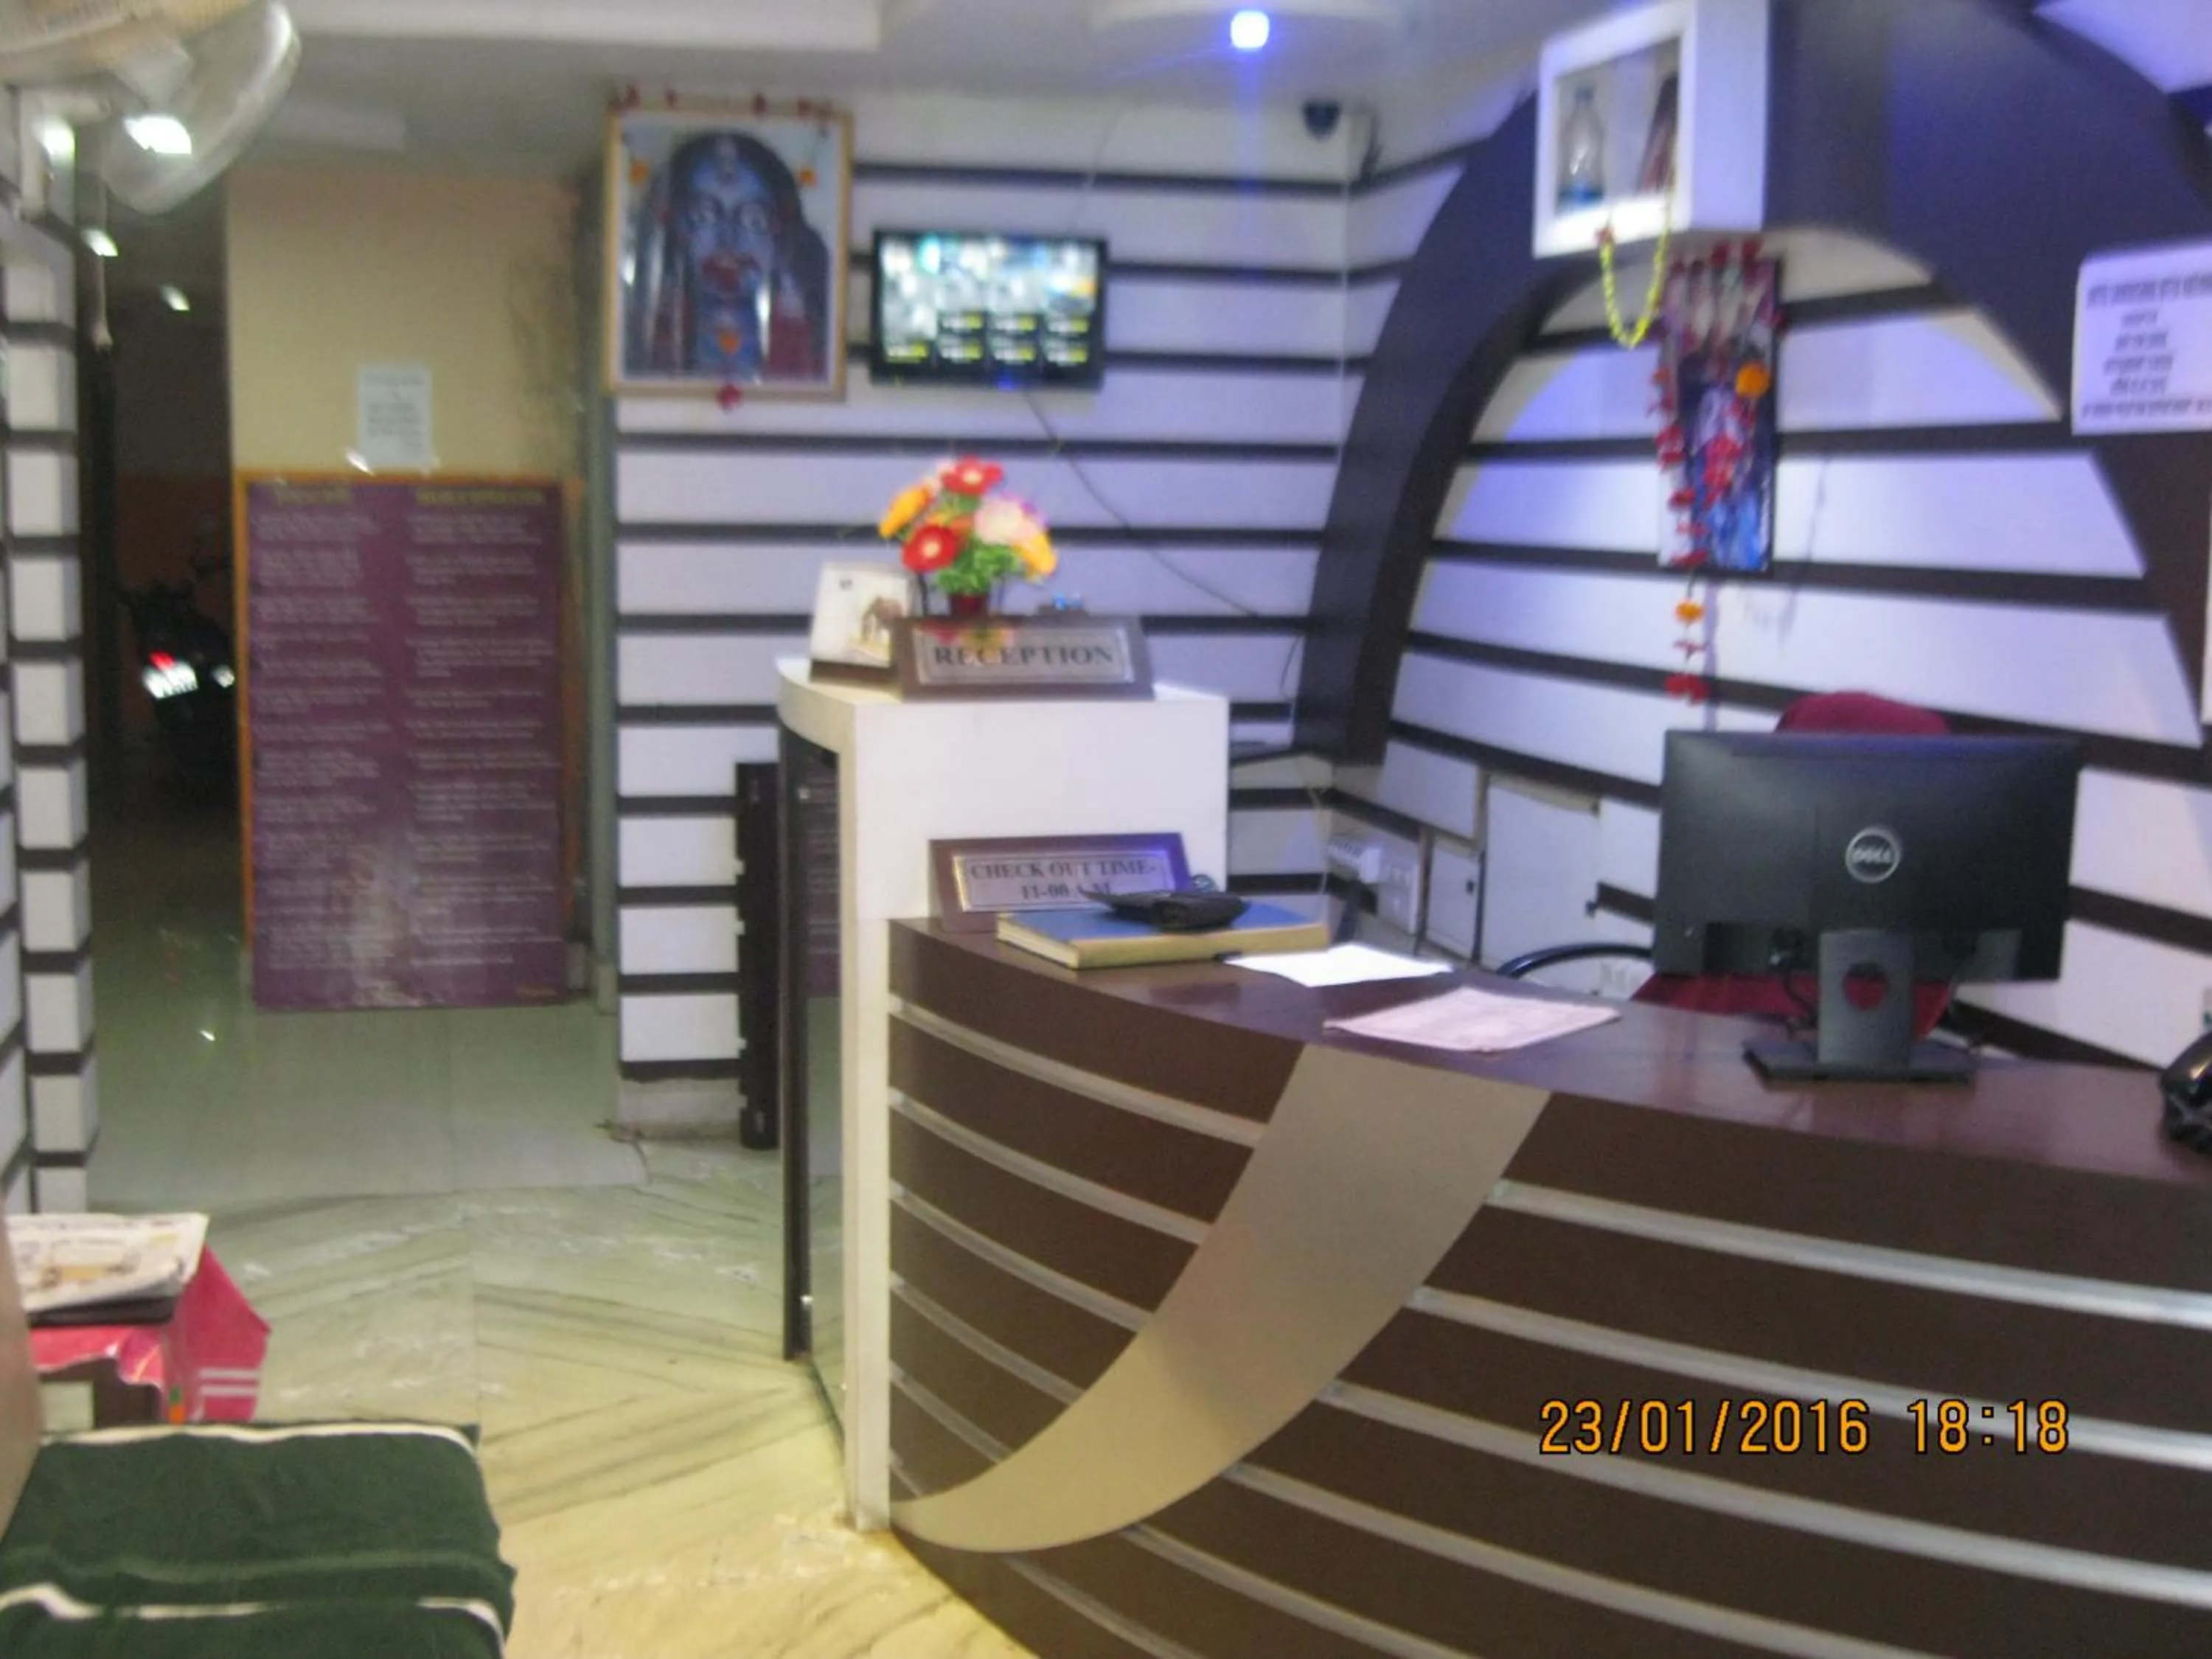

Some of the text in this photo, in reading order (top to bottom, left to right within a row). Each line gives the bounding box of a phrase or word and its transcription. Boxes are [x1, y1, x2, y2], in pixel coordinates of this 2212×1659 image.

[934, 646, 1114, 664] RECEPTION
[970, 860, 1046, 880] CHECK
[1049, 860, 1092, 877] OUT
